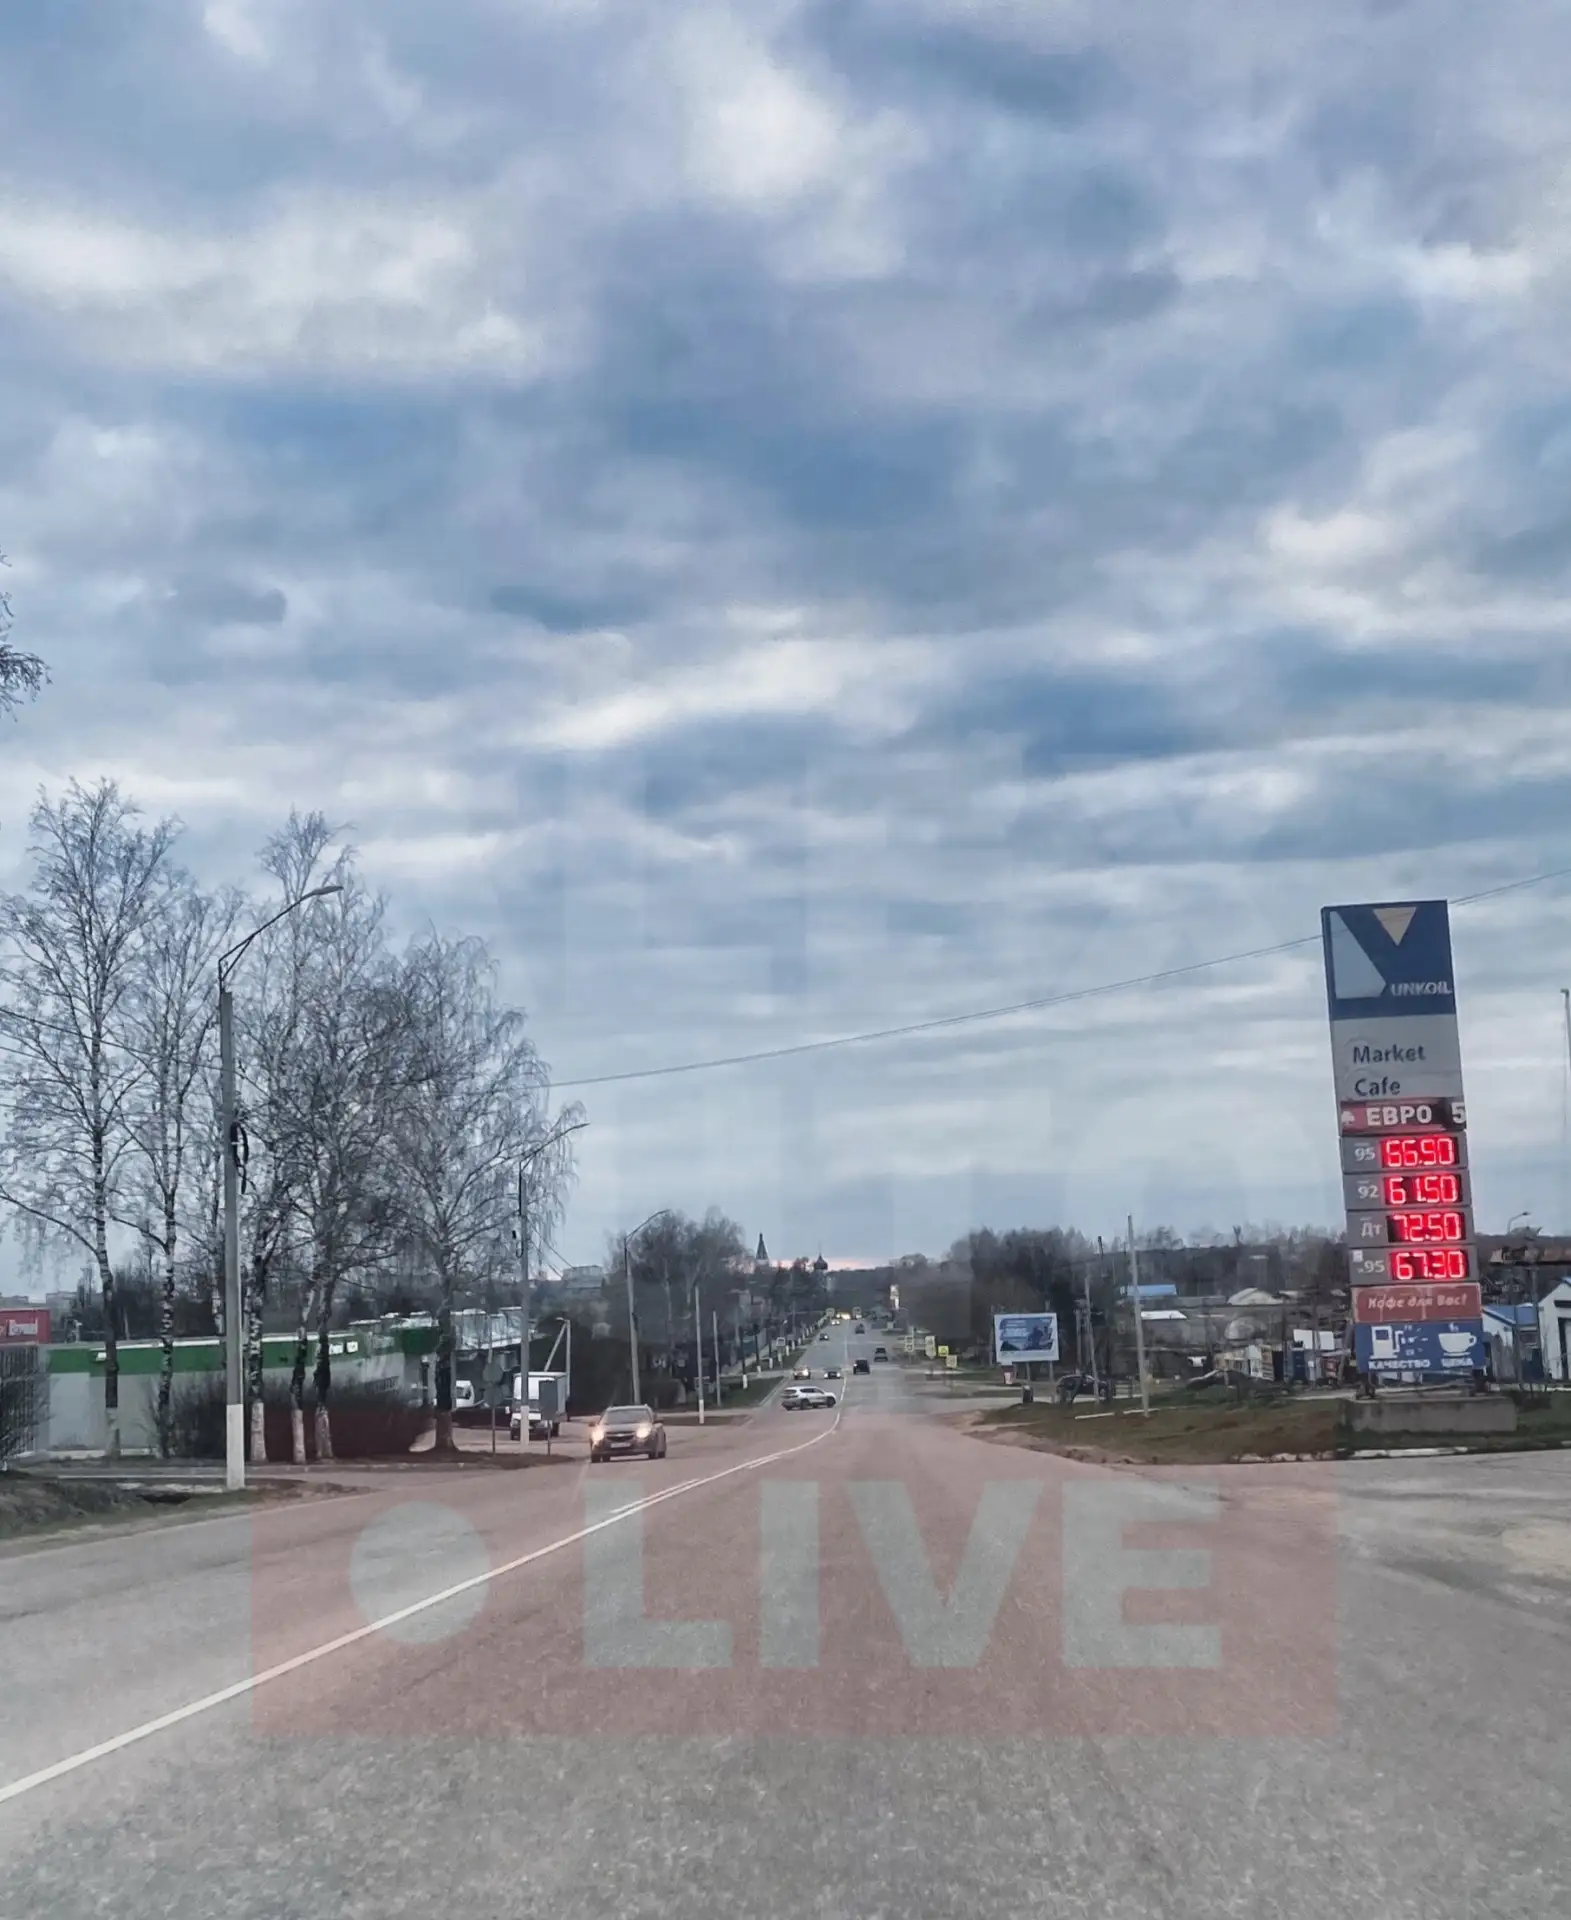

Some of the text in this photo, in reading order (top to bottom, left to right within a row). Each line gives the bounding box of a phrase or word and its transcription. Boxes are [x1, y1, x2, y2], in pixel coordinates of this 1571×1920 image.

[1353, 1044, 1426, 1065] Market
[1354, 1076, 1401, 1097] Cafe
[1366, 1105, 1433, 1126] ЕВРО
[1354, 1147, 1376, 1161] 95
[1357, 1185, 1380, 1199] 92
[1368, 1296, 1404, 1309] Кофе
